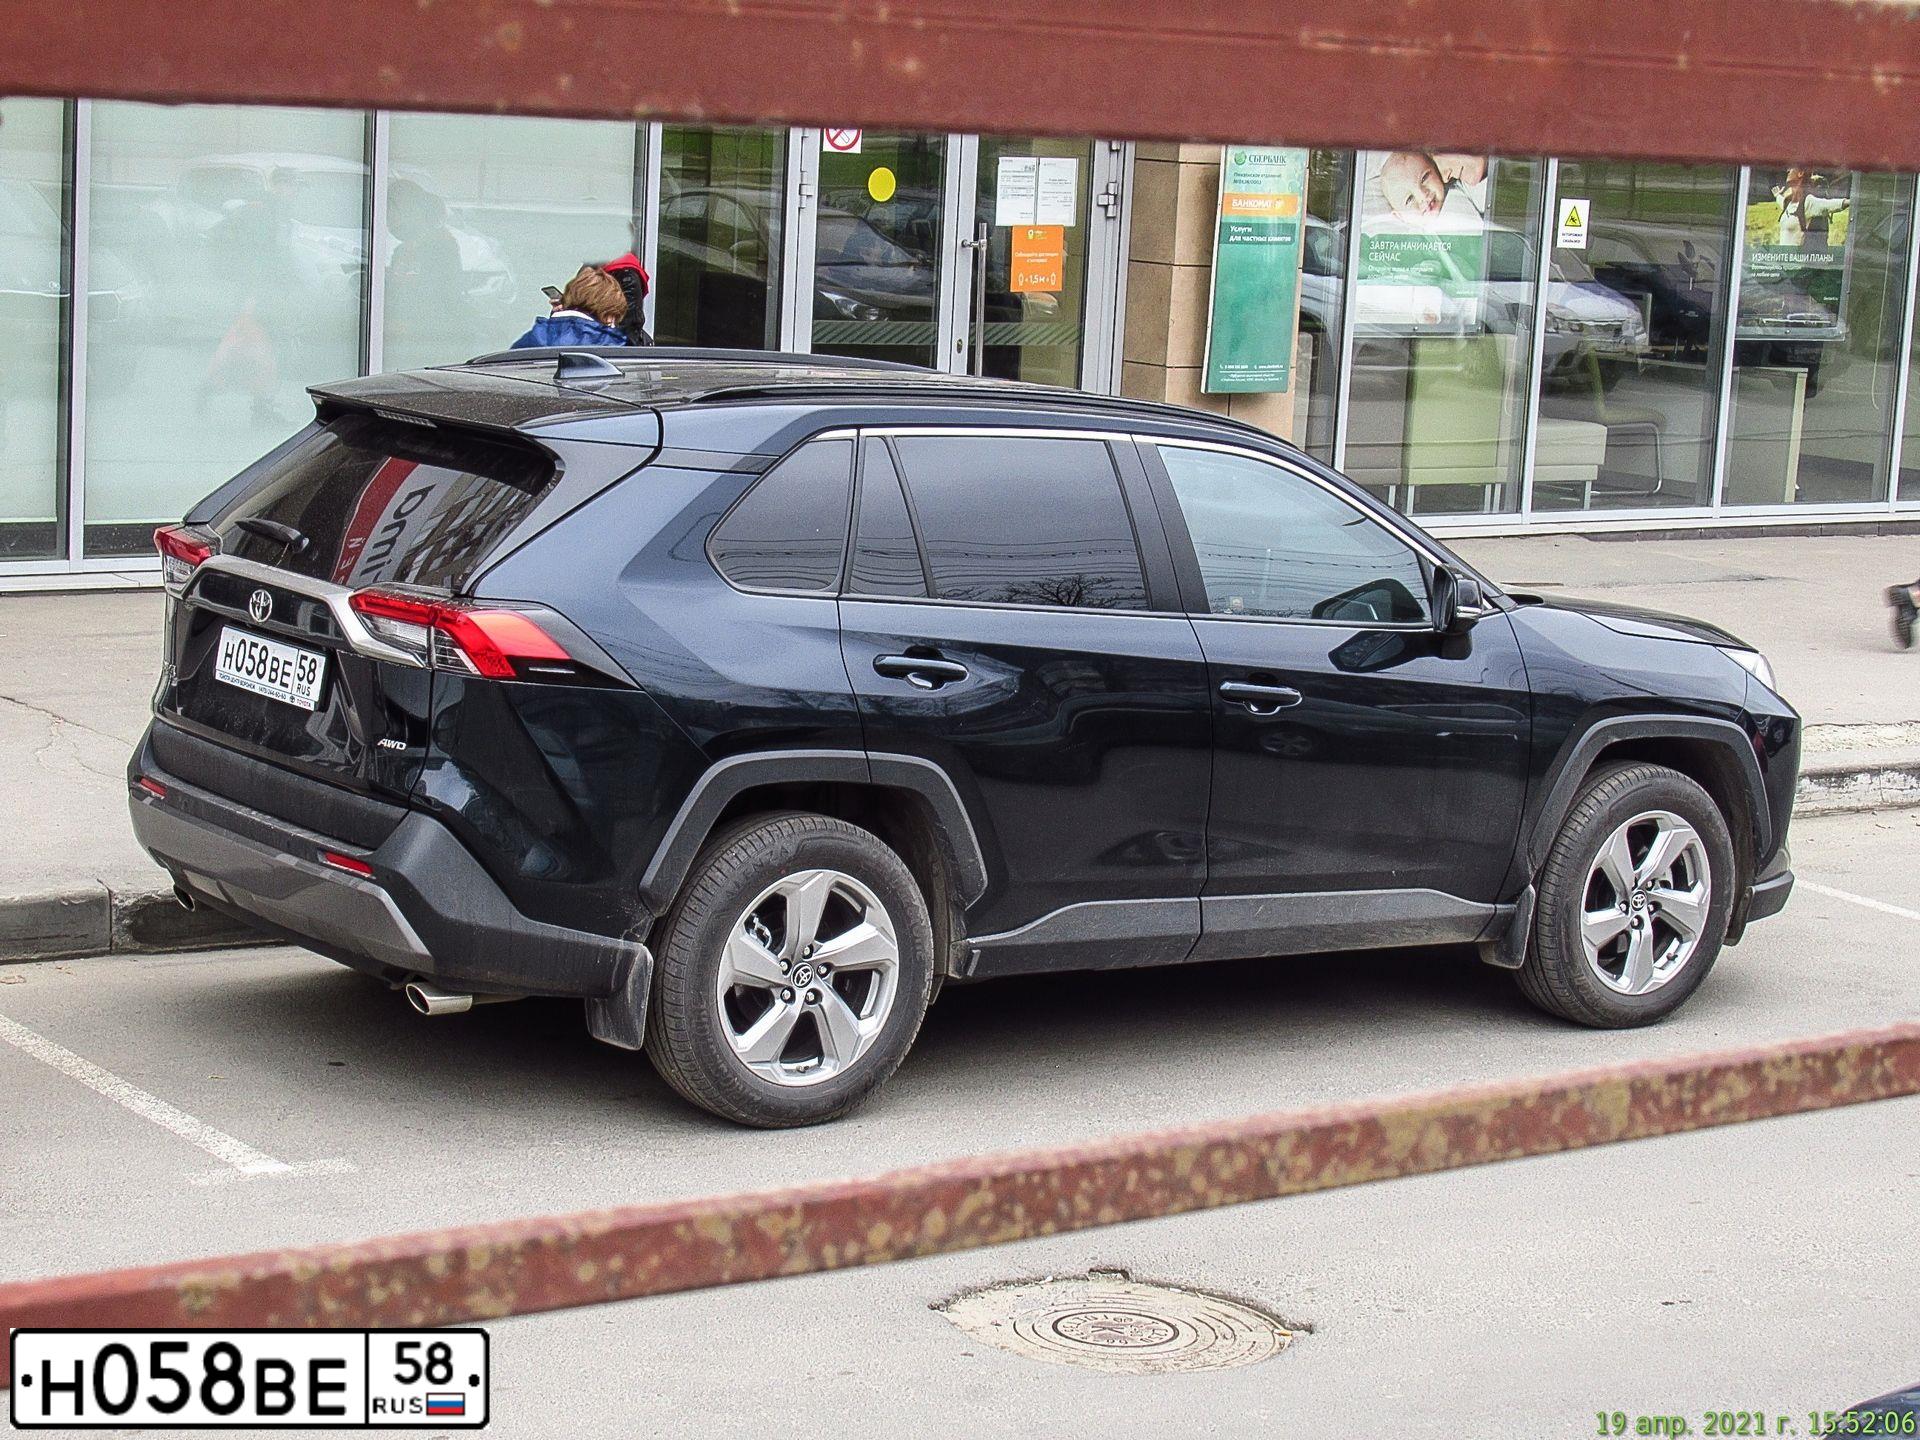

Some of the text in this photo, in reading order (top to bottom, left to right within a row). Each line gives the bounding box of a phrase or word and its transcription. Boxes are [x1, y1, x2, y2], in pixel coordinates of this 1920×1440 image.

[1249, 154, 1286, 164] СБЕРБАНК
[1232, 199, 1271, 208] БАНКОМАТ
[1230, 225, 1252, 233] Услуги
[1369, 241, 1452, 251] ЗАВТРА НАЧИНАЕТСЯ
[1368, 251, 1401, 261] СЕЙЧАС
[1752, 253, 1834, 262] ИЗМЕНИТЕ ВАШИ ПЛАНЫ
[222, 638, 317, 689] Н058ВЕ 58
[296, 683, 311, 697] RUS
[377, 738, 407, 751] AWD
